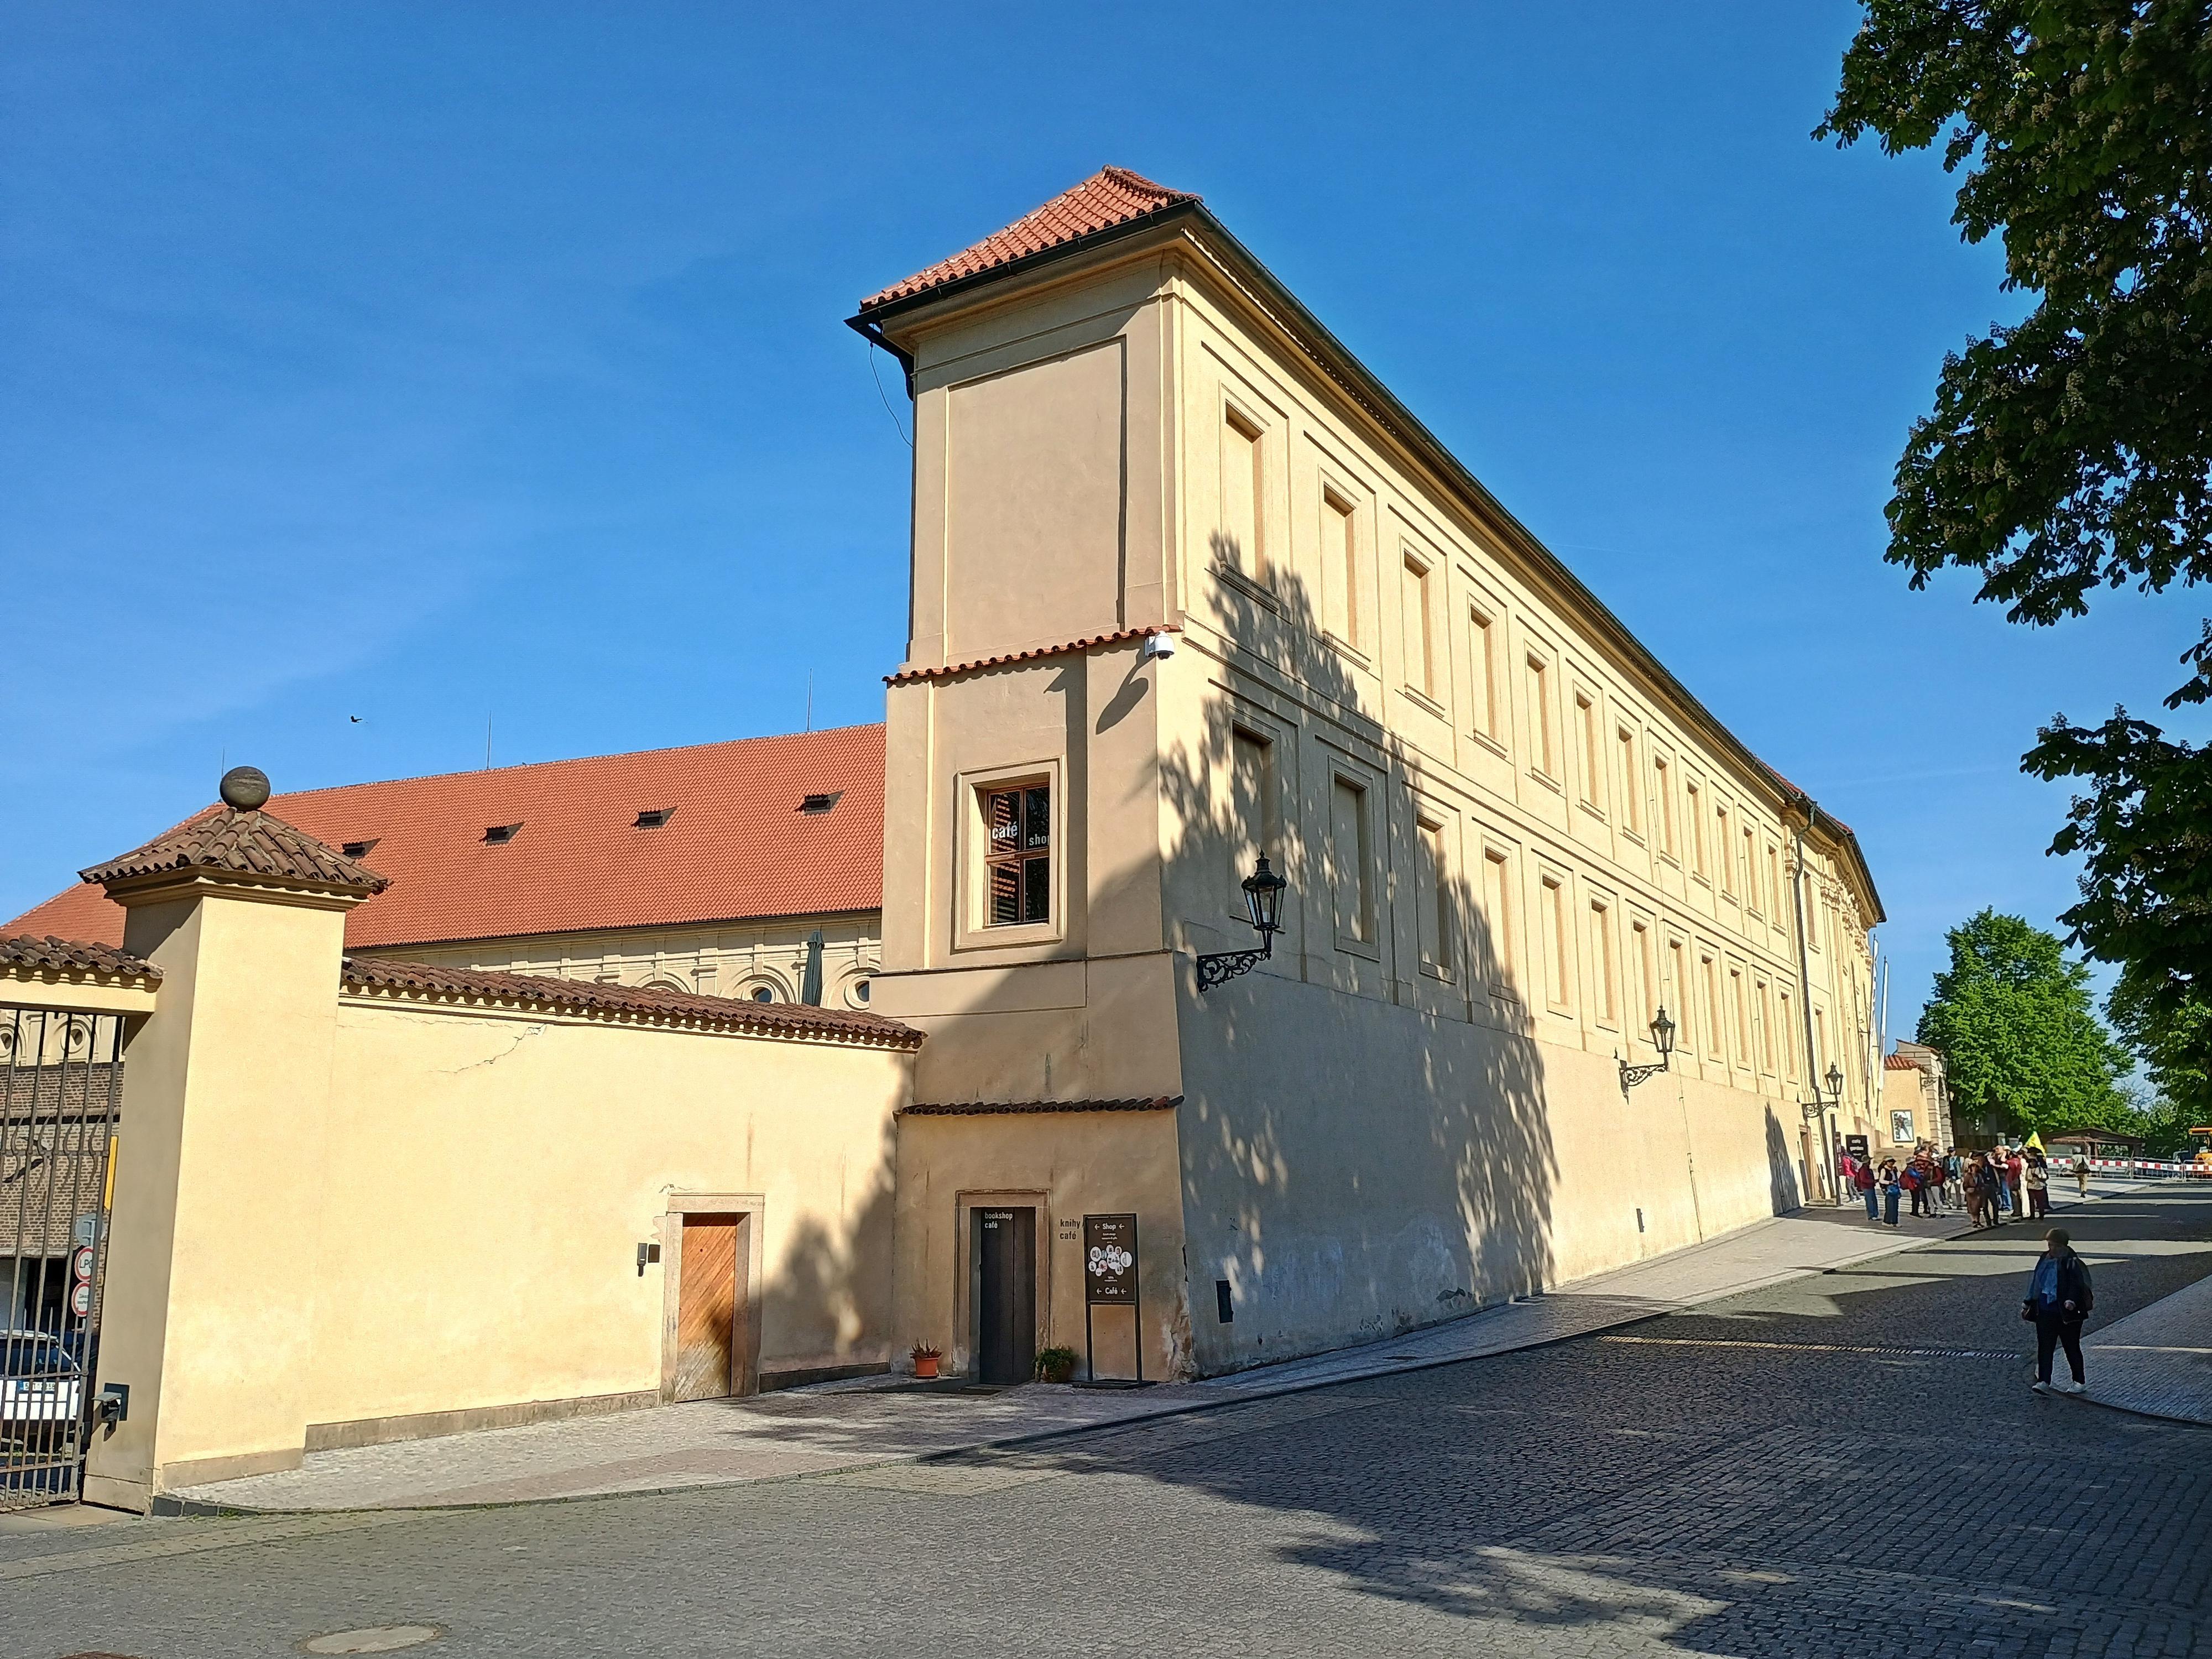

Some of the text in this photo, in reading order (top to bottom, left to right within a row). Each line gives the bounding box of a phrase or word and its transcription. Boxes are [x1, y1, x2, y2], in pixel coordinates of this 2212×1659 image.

[992, 821, 1018, 839] café
[984, 1212, 1013, 1221] bookshop
[984, 1220, 998, 1229] café
[1060, 1218, 1081, 1229] knihy
[1102, 1223, 1117, 1231] Shop
[1060, 1230, 1077, 1240] café
